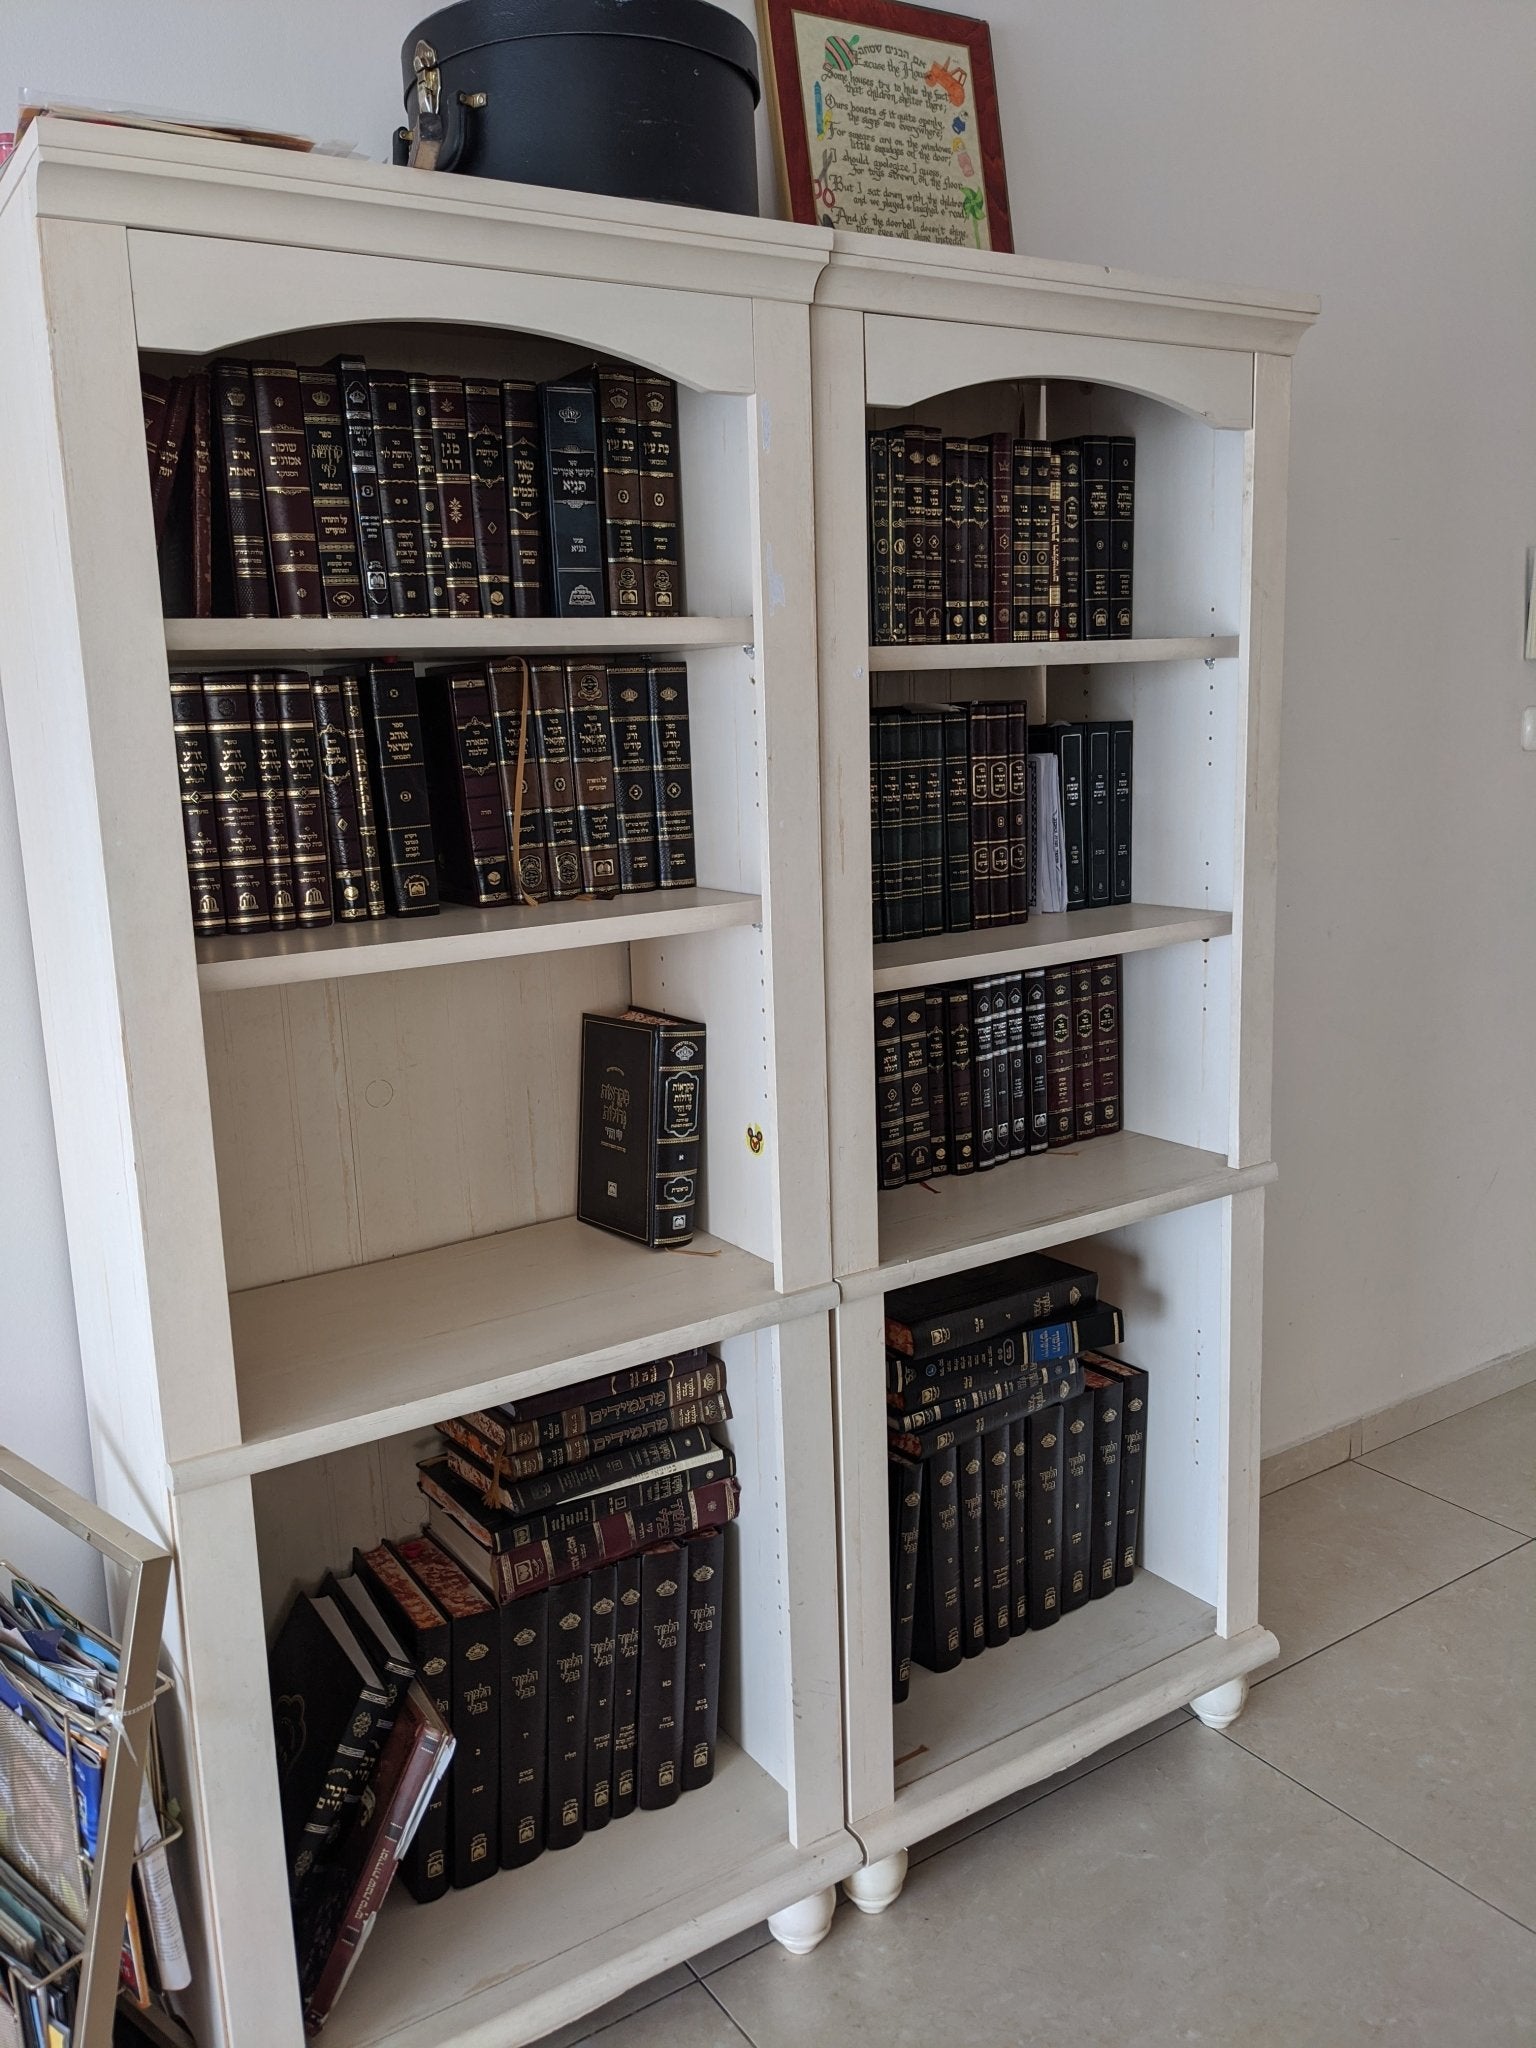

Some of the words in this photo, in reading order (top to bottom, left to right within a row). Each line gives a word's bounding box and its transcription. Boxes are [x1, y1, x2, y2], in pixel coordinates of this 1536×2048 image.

[885, 45, 910, 60] הבנים
[441, 442, 461, 457] מגן
[622, 439, 635, 452] בת
[657, 443, 670, 456] בת
[269, 456, 302, 466] אמונים
[442, 458, 462, 471] דוד
[562, 480, 587, 494] תניא
[386, 741, 413, 752] ישראל
[180, 763, 208, 775] קודש
[220, 762, 247, 774] קודש
[260, 760, 281, 772] קודש
[288, 760, 314, 772] קודש
[373, 1848, 390, 1879] זמירות
[364, 1878, 377, 1898] שבת
